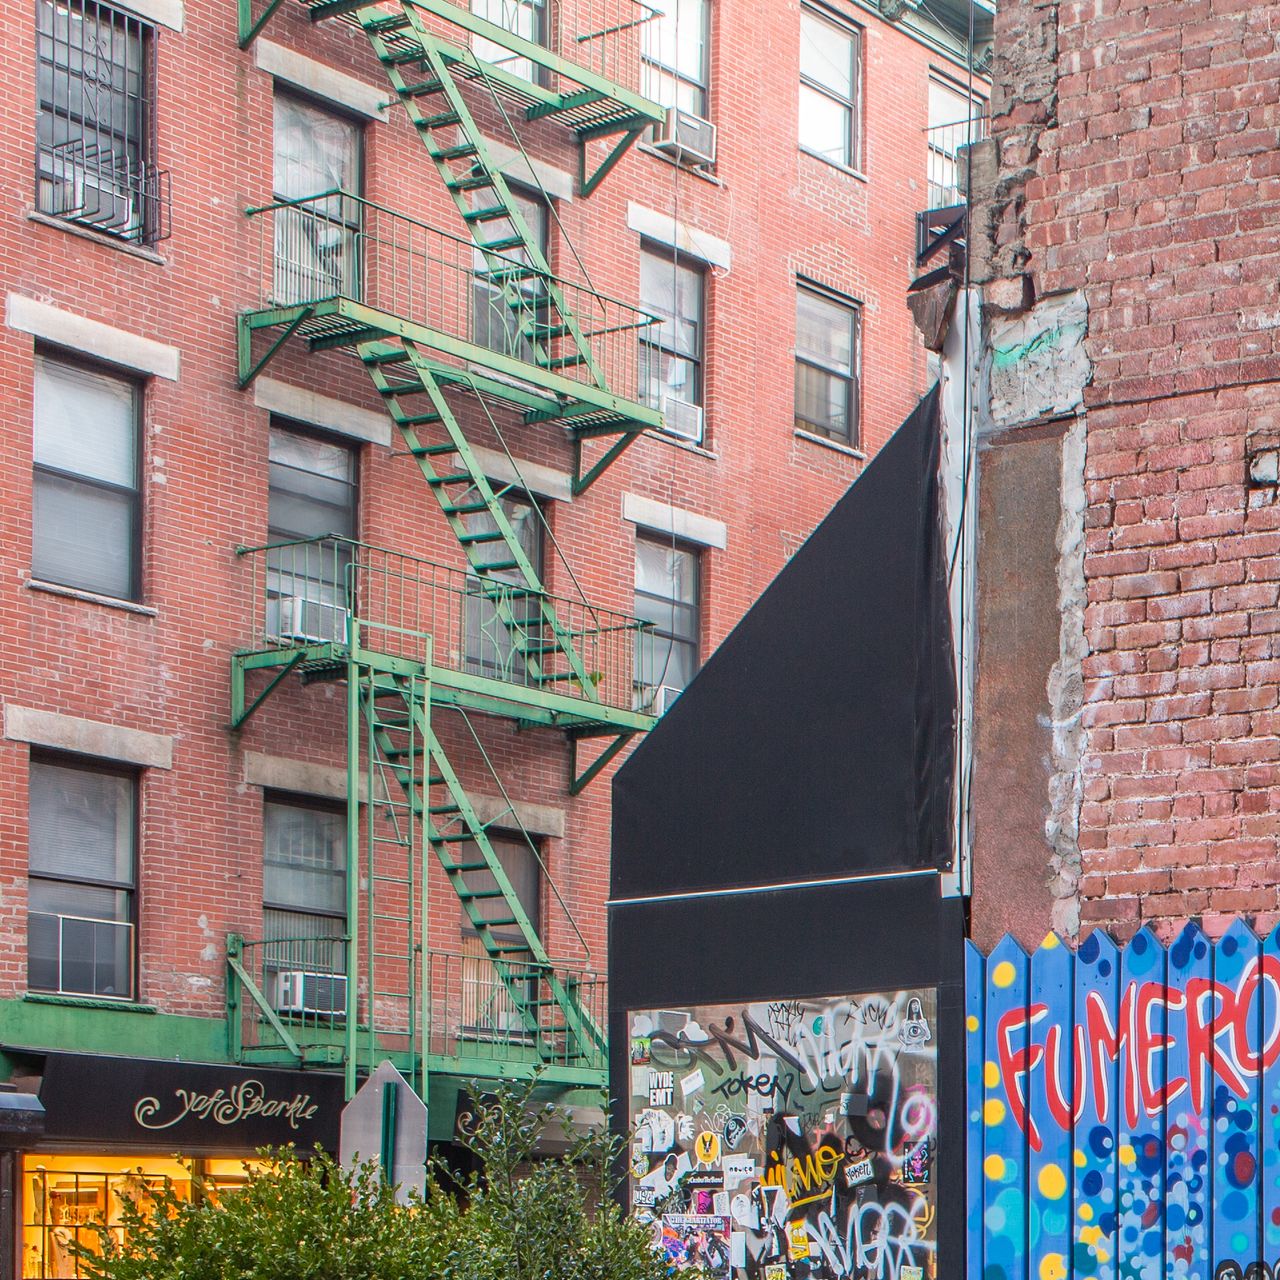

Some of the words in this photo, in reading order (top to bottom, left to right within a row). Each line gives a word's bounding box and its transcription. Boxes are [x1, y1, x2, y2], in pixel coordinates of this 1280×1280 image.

[649, 1072, 674, 1088] WYDE
[213, 1079, 320, 1130] Sparkle
[649, 1089, 674, 1106] EMT
